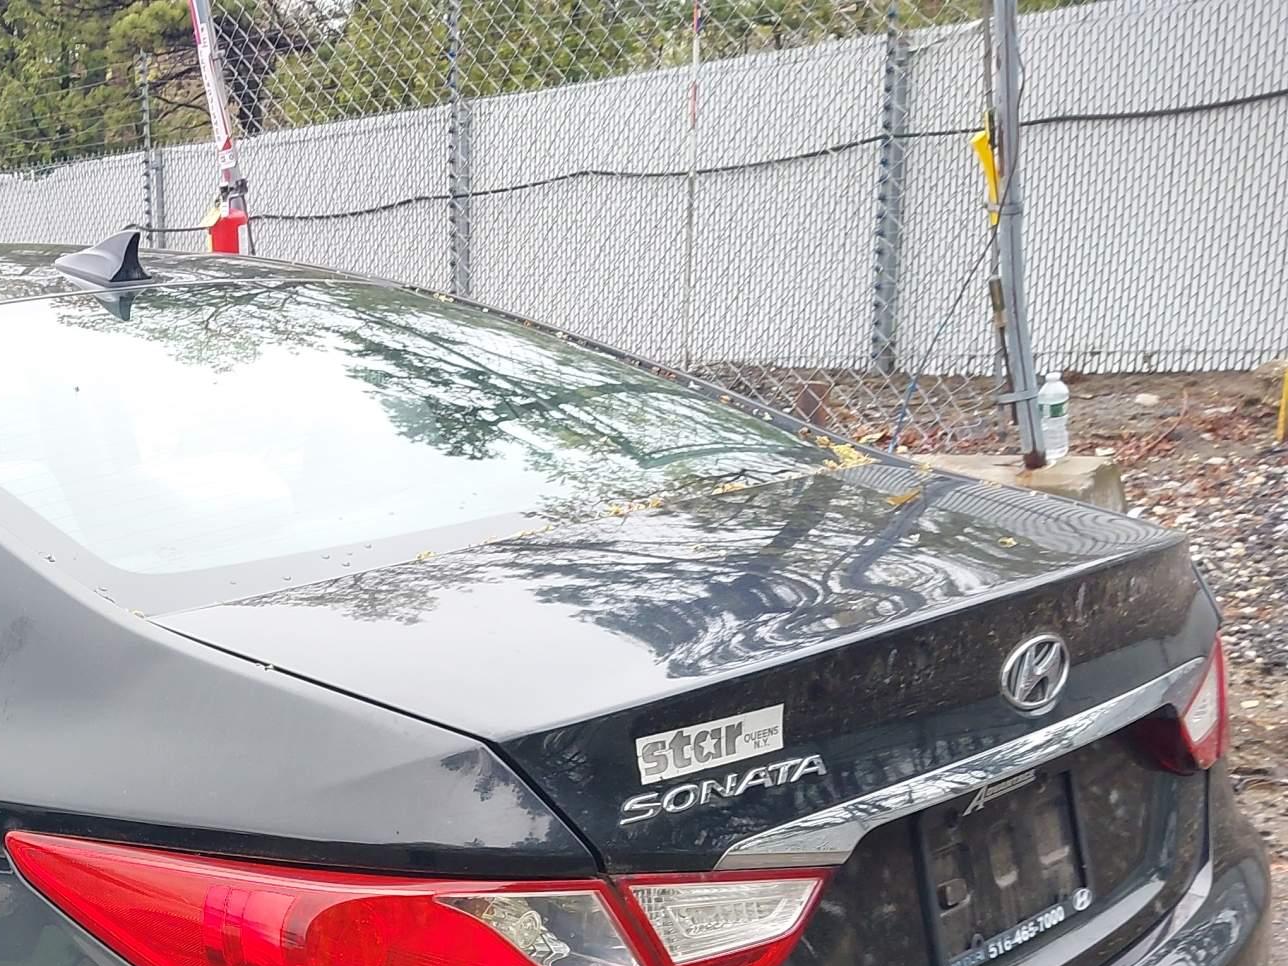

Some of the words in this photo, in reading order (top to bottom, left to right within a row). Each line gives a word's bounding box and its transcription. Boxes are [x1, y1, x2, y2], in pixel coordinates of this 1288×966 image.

[641, 720, 743, 776] star
[744, 725, 779, 743] QUEENS
[619, 754, 827, 825] SONATA
[988, 906, 1065, 959] 516-465-7000
